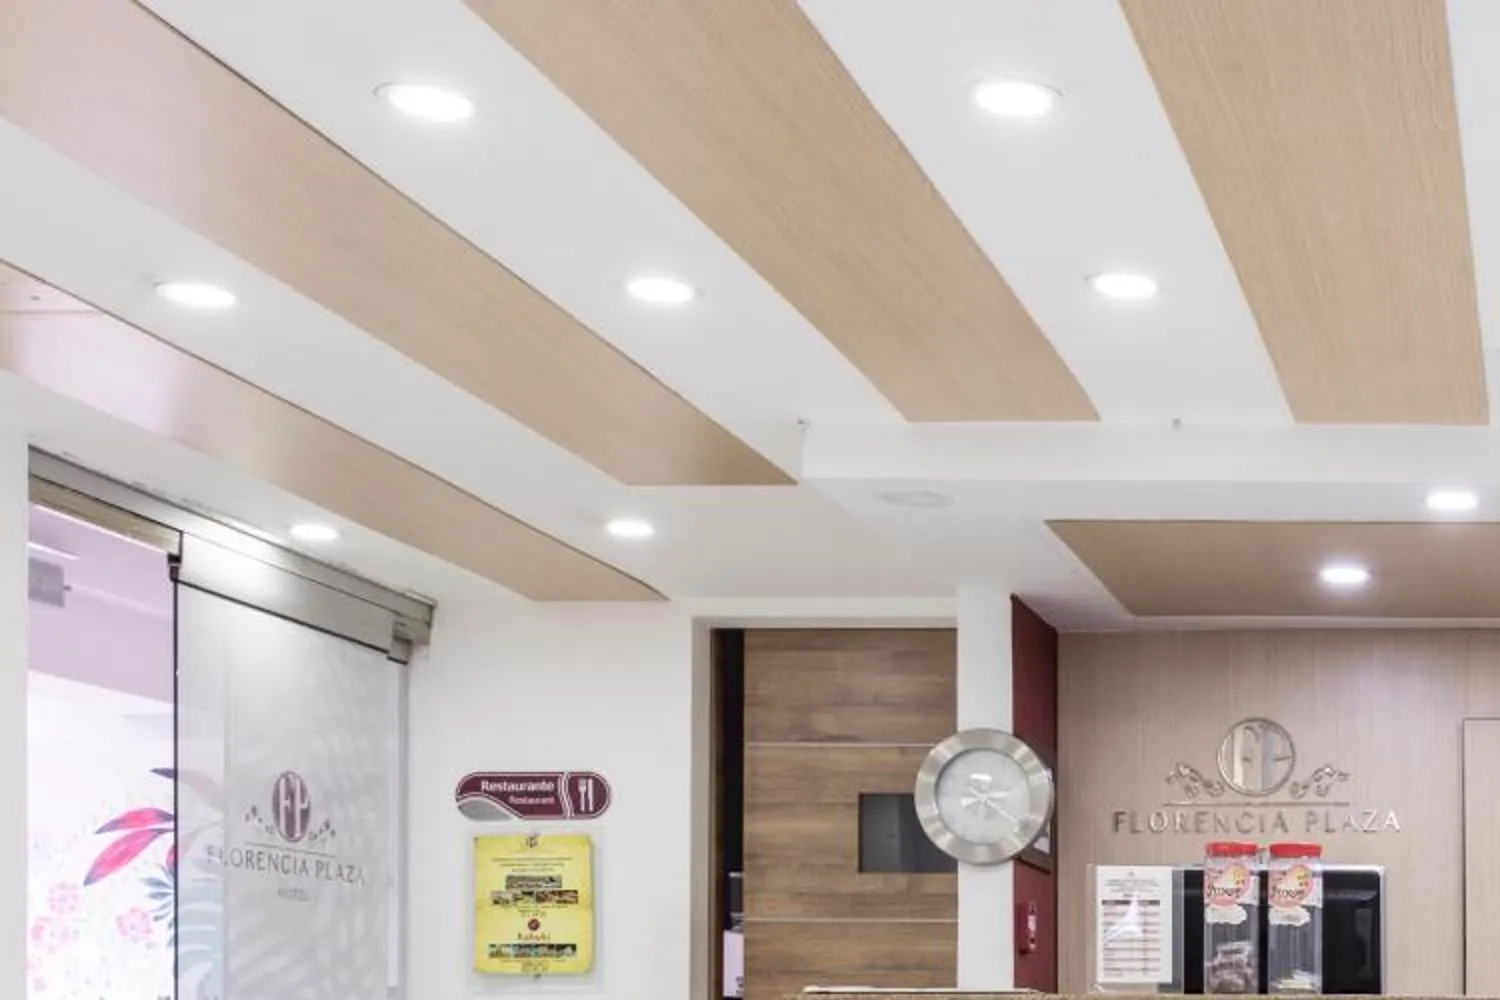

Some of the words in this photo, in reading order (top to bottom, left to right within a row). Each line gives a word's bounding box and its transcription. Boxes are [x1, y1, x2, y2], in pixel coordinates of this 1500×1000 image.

[481, 779, 555, 792] Restaurante
[1112, 810, 1289, 834] FLORENCIA
[1305, 809, 1401, 834] PLAZA
[206, 844, 309, 878] FLORENCIA
[314, 859, 366, 887] PLAZA
